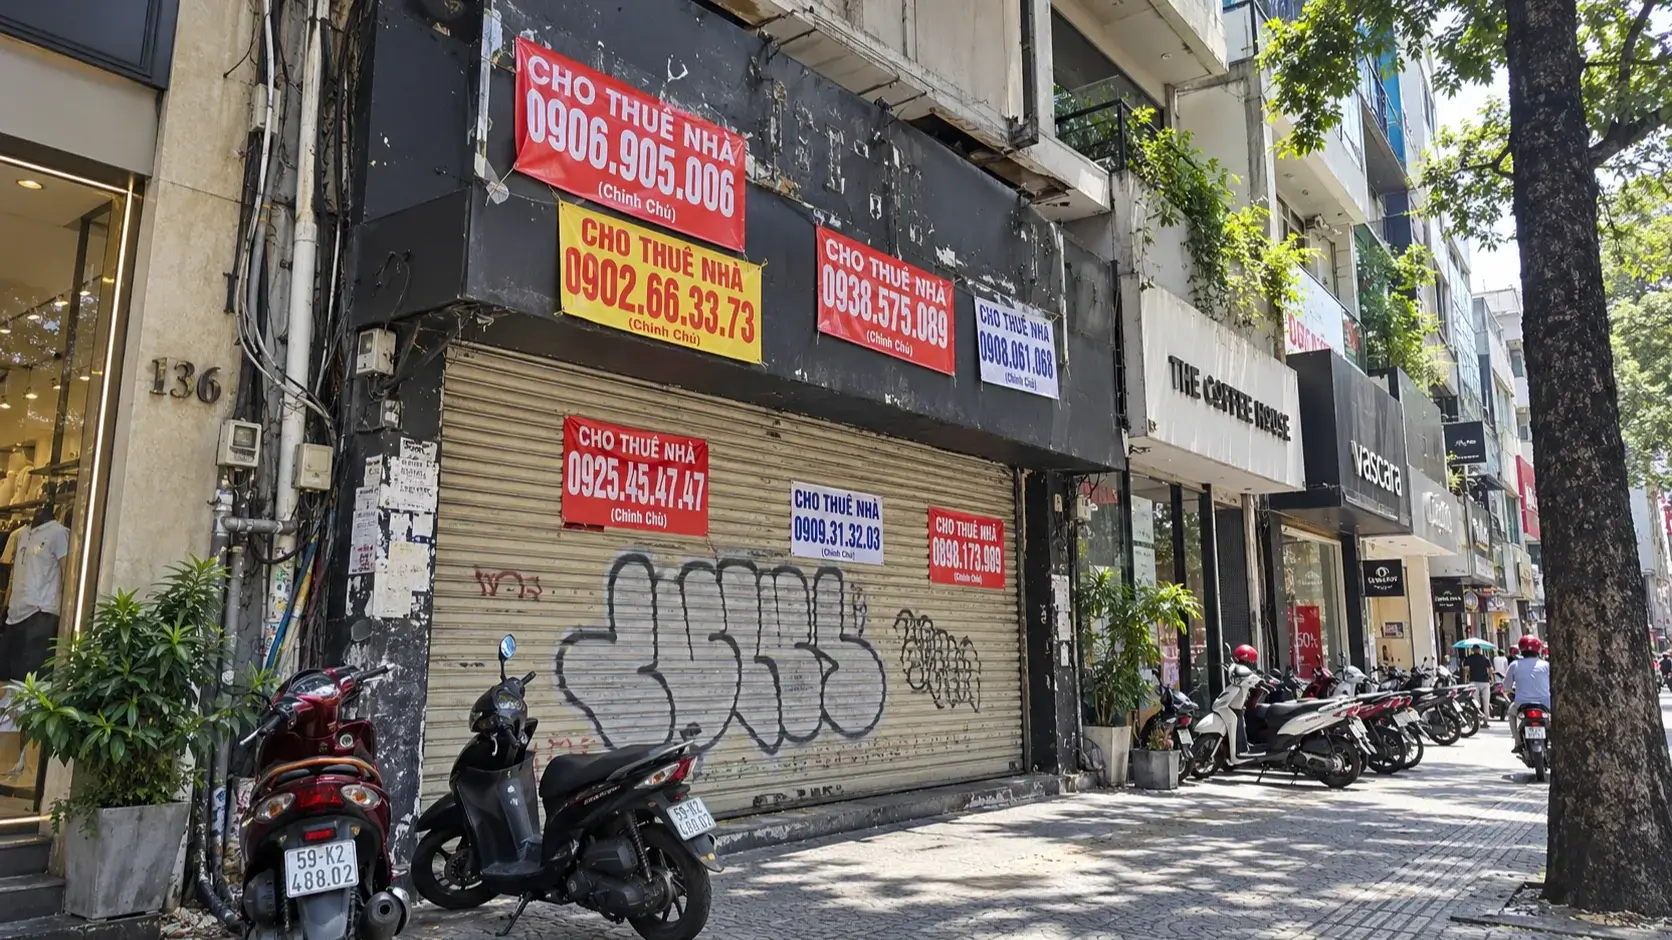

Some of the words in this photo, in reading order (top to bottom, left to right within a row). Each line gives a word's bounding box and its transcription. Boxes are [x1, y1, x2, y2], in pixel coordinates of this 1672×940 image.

[527, 55, 596, 105] CHO
[605, 87, 675, 142] THUÊ
[684, 123, 736, 167] NHÀ
[526, 87, 735, 219] 0906.905.006
[581, 217, 631, 257] CHO
[638, 235, 695, 278] THUÊ
[701, 256, 744, 293] NHÀ
[825, 238, 865, 272] CHO
[868, 257, 911, 291] THUÊ
[914, 277, 947, 307] NHÀ
[565, 246, 755, 344] 0902.66.33.73
[822, 263, 948, 350] 0938.575.089
[979, 304, 1001, 328] CHO
[150, 356, 222, 404] 136
[979, 330, 1054, 380] 0908.061.068
[1168, 355, 1201, 400] THE
[1202, 374, 1254, 425] COFFEE
[1254, 400, 1291, 442] HOUSE
[578, 425, 615, 451] CHO
[619, 433, 660, 459] THUÊ
[664, 441, 696, 465] NHÀ
[1350, 439, 1403, 497] vascara
[567, 450, 705, 512] 0925.45.47.47
[794, 489, 820, 511] CHO
[823, 493, 853, 516] THUÊ
[794, 515, 880, 551] 0909.31.32.03
[935, 516, 955, 535] CHO
[291, 864, 354, 892] 488.02
[296, 844, 346, 870] 59-K2
